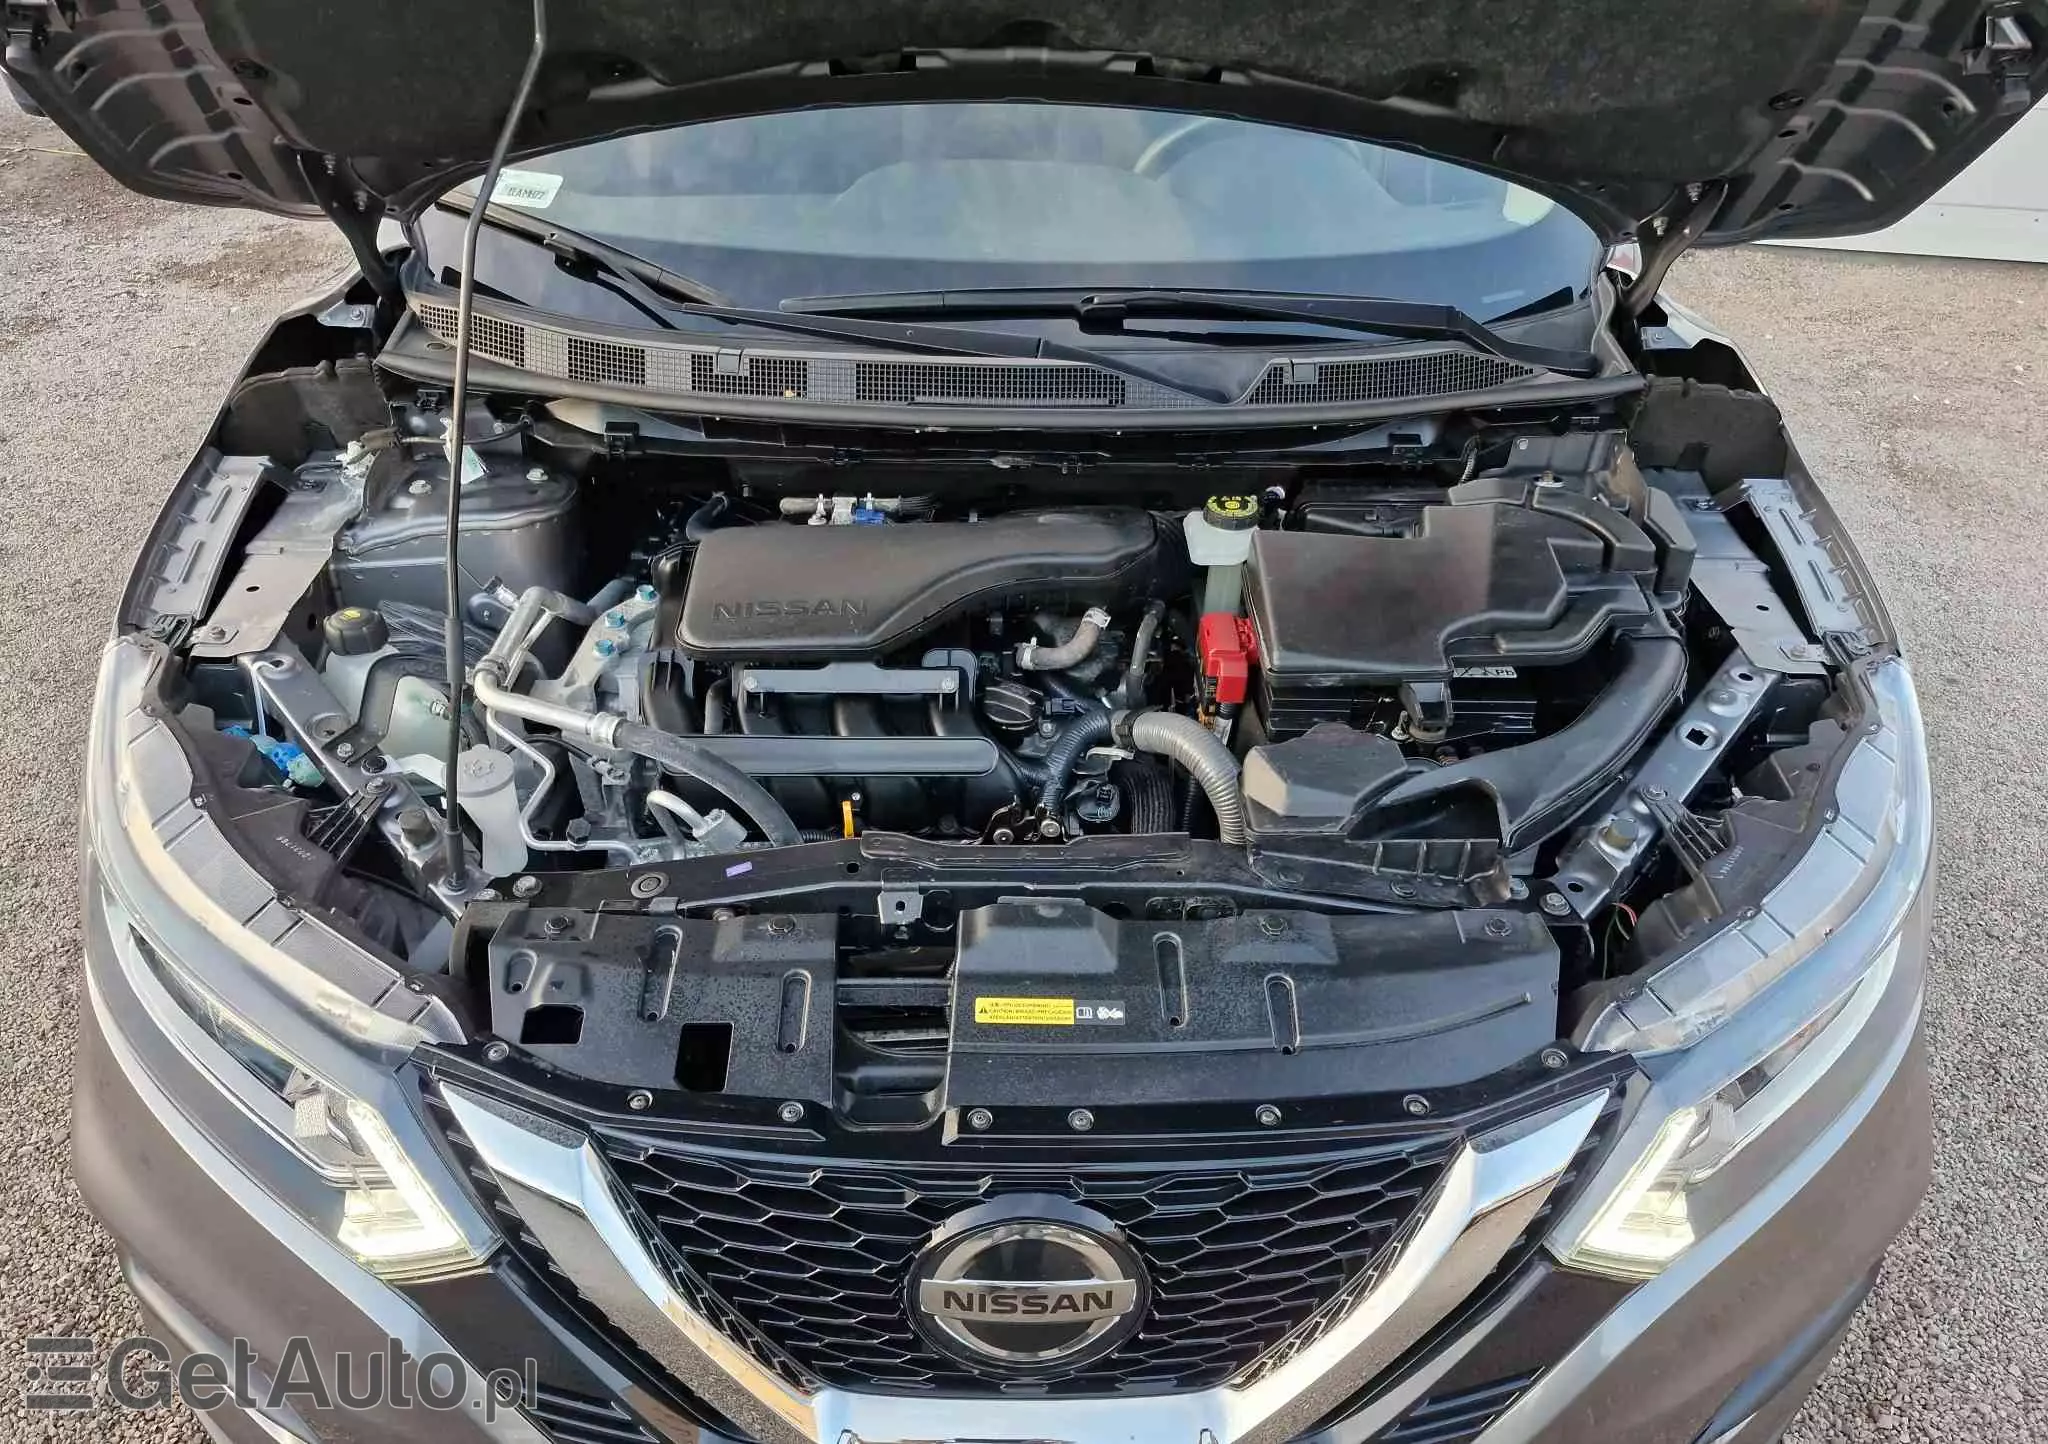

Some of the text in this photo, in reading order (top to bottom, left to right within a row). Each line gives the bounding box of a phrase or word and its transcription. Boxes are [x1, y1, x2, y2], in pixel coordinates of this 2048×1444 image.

[712, 599, 868, 621] NISSAN
[1495, 668, 1514, 676] Pb
[943, 1290, 1113, 1315] NISSAN
